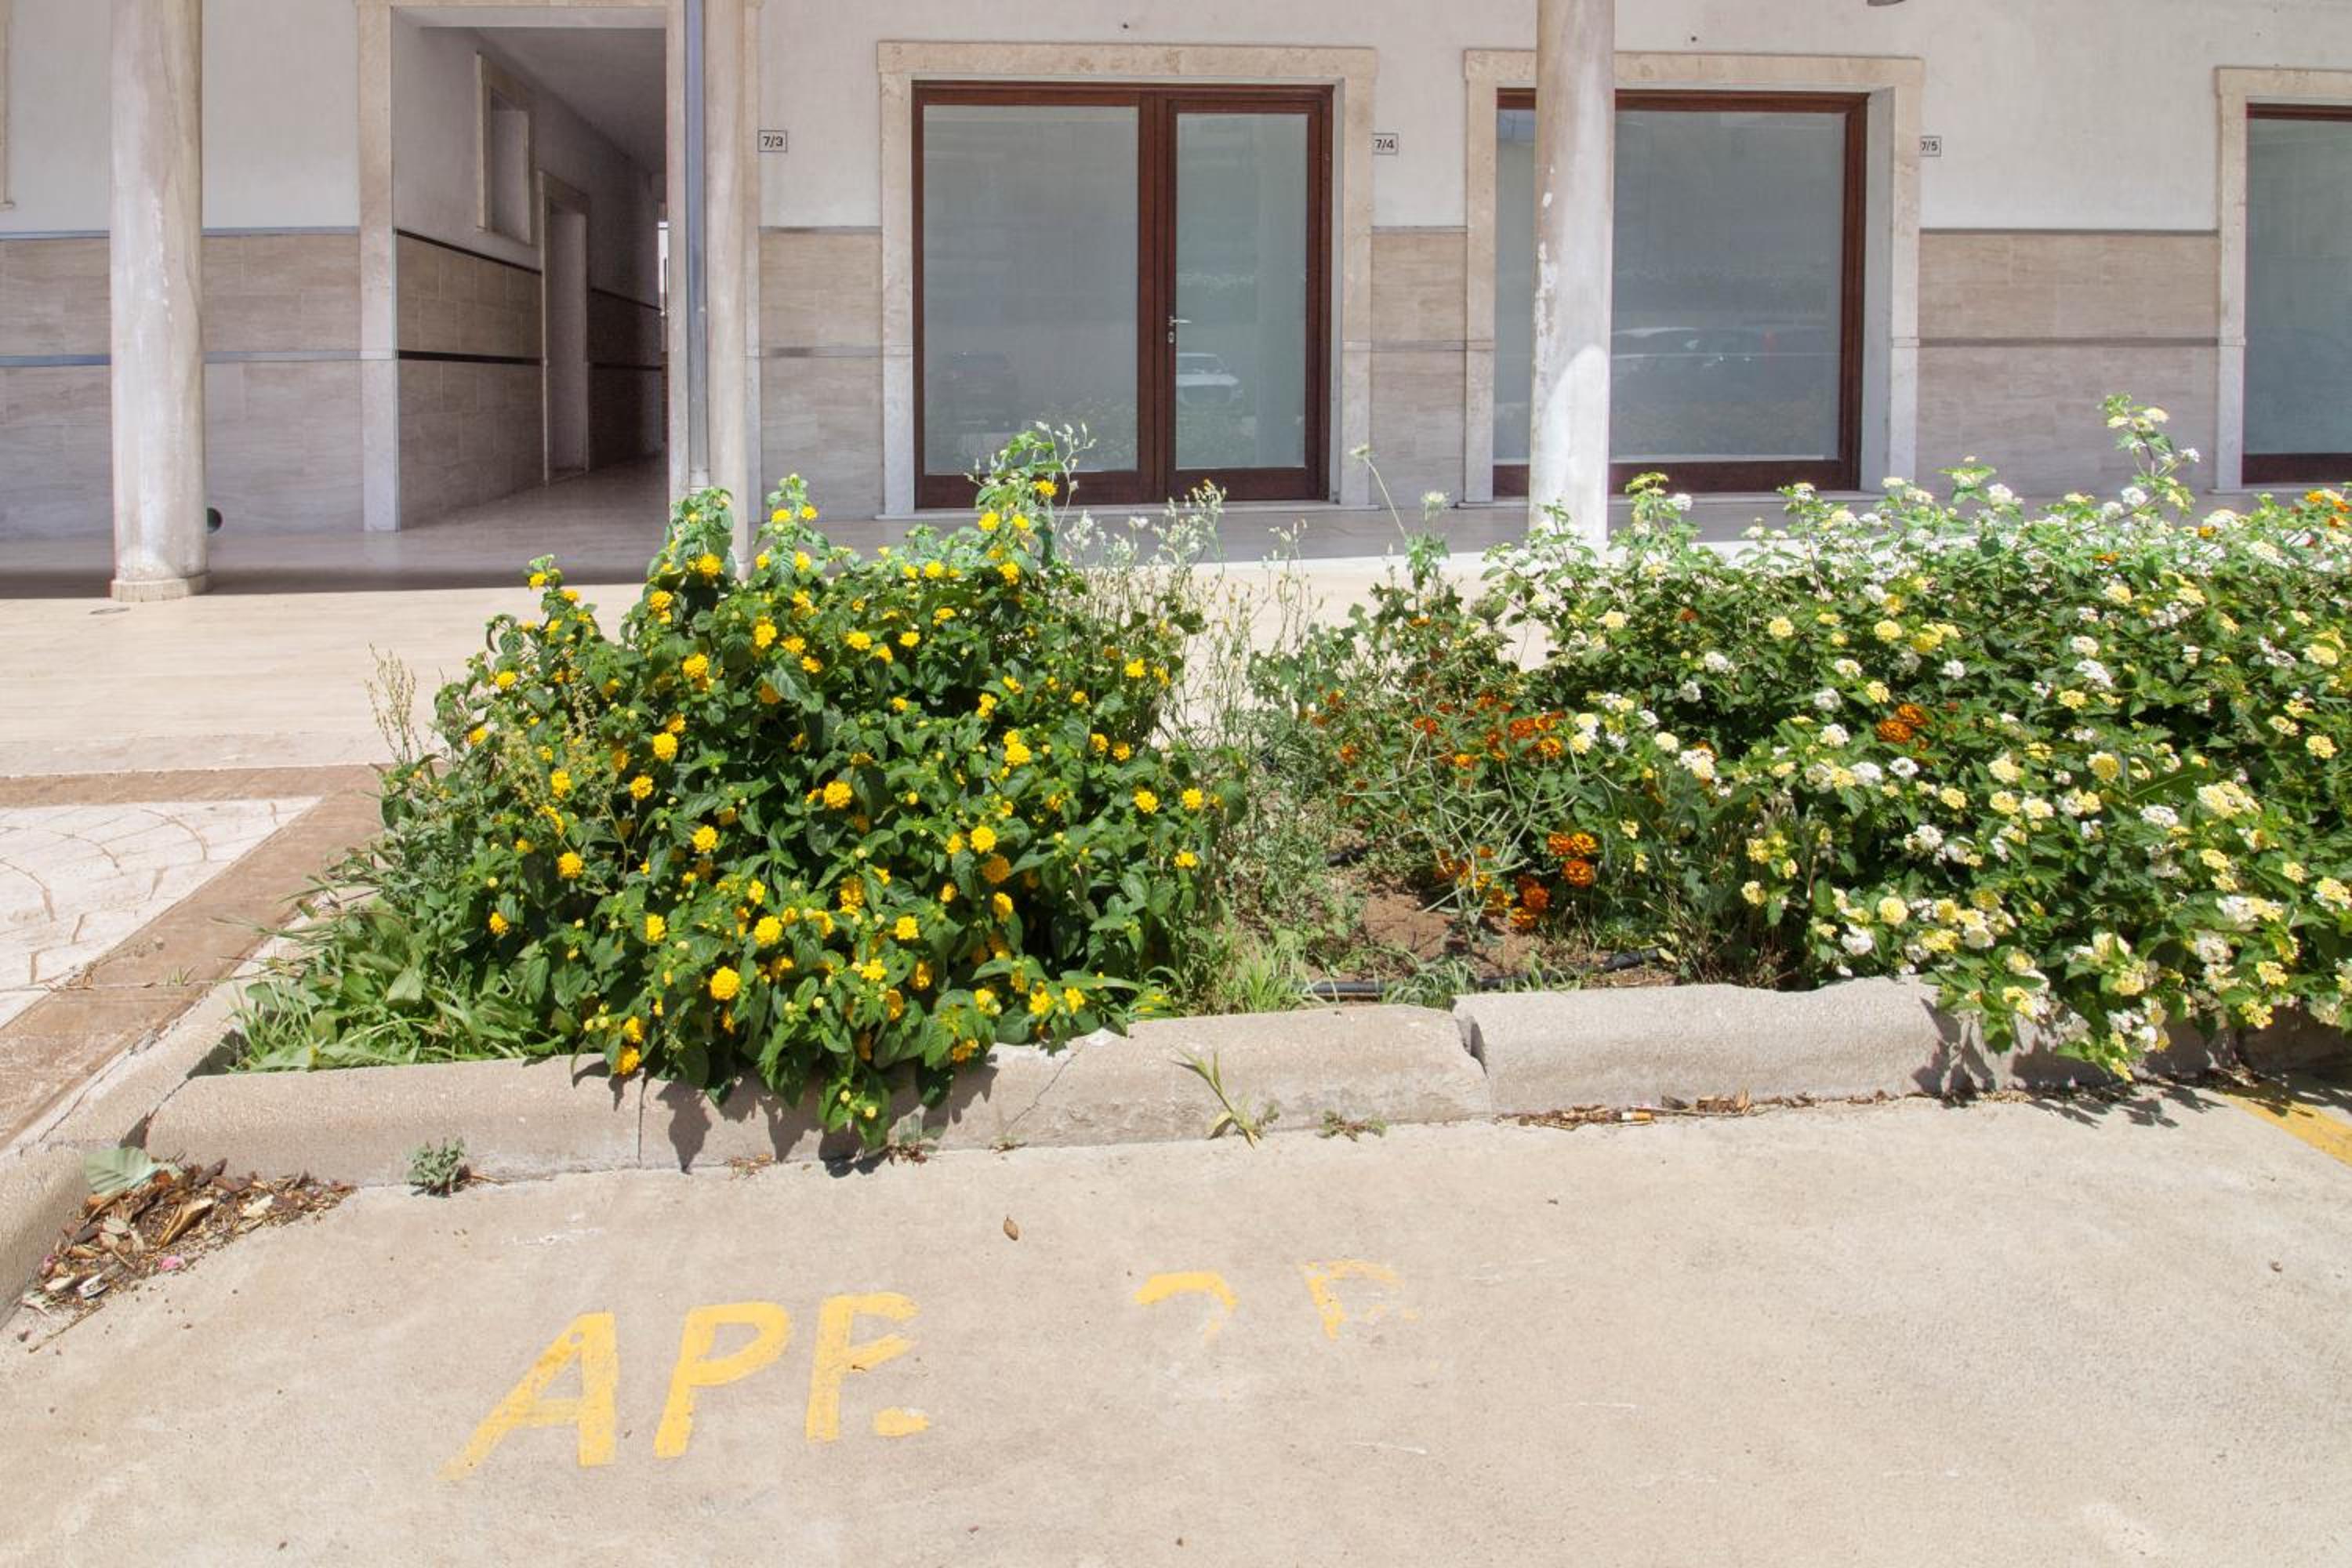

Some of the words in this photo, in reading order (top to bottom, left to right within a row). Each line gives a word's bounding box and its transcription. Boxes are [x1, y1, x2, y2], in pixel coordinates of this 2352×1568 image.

[763, 135, 783, 148] 7/3
[1374, 139, 1394, 151] 7/4
[1920, 140, 1938, 151] 7/5
